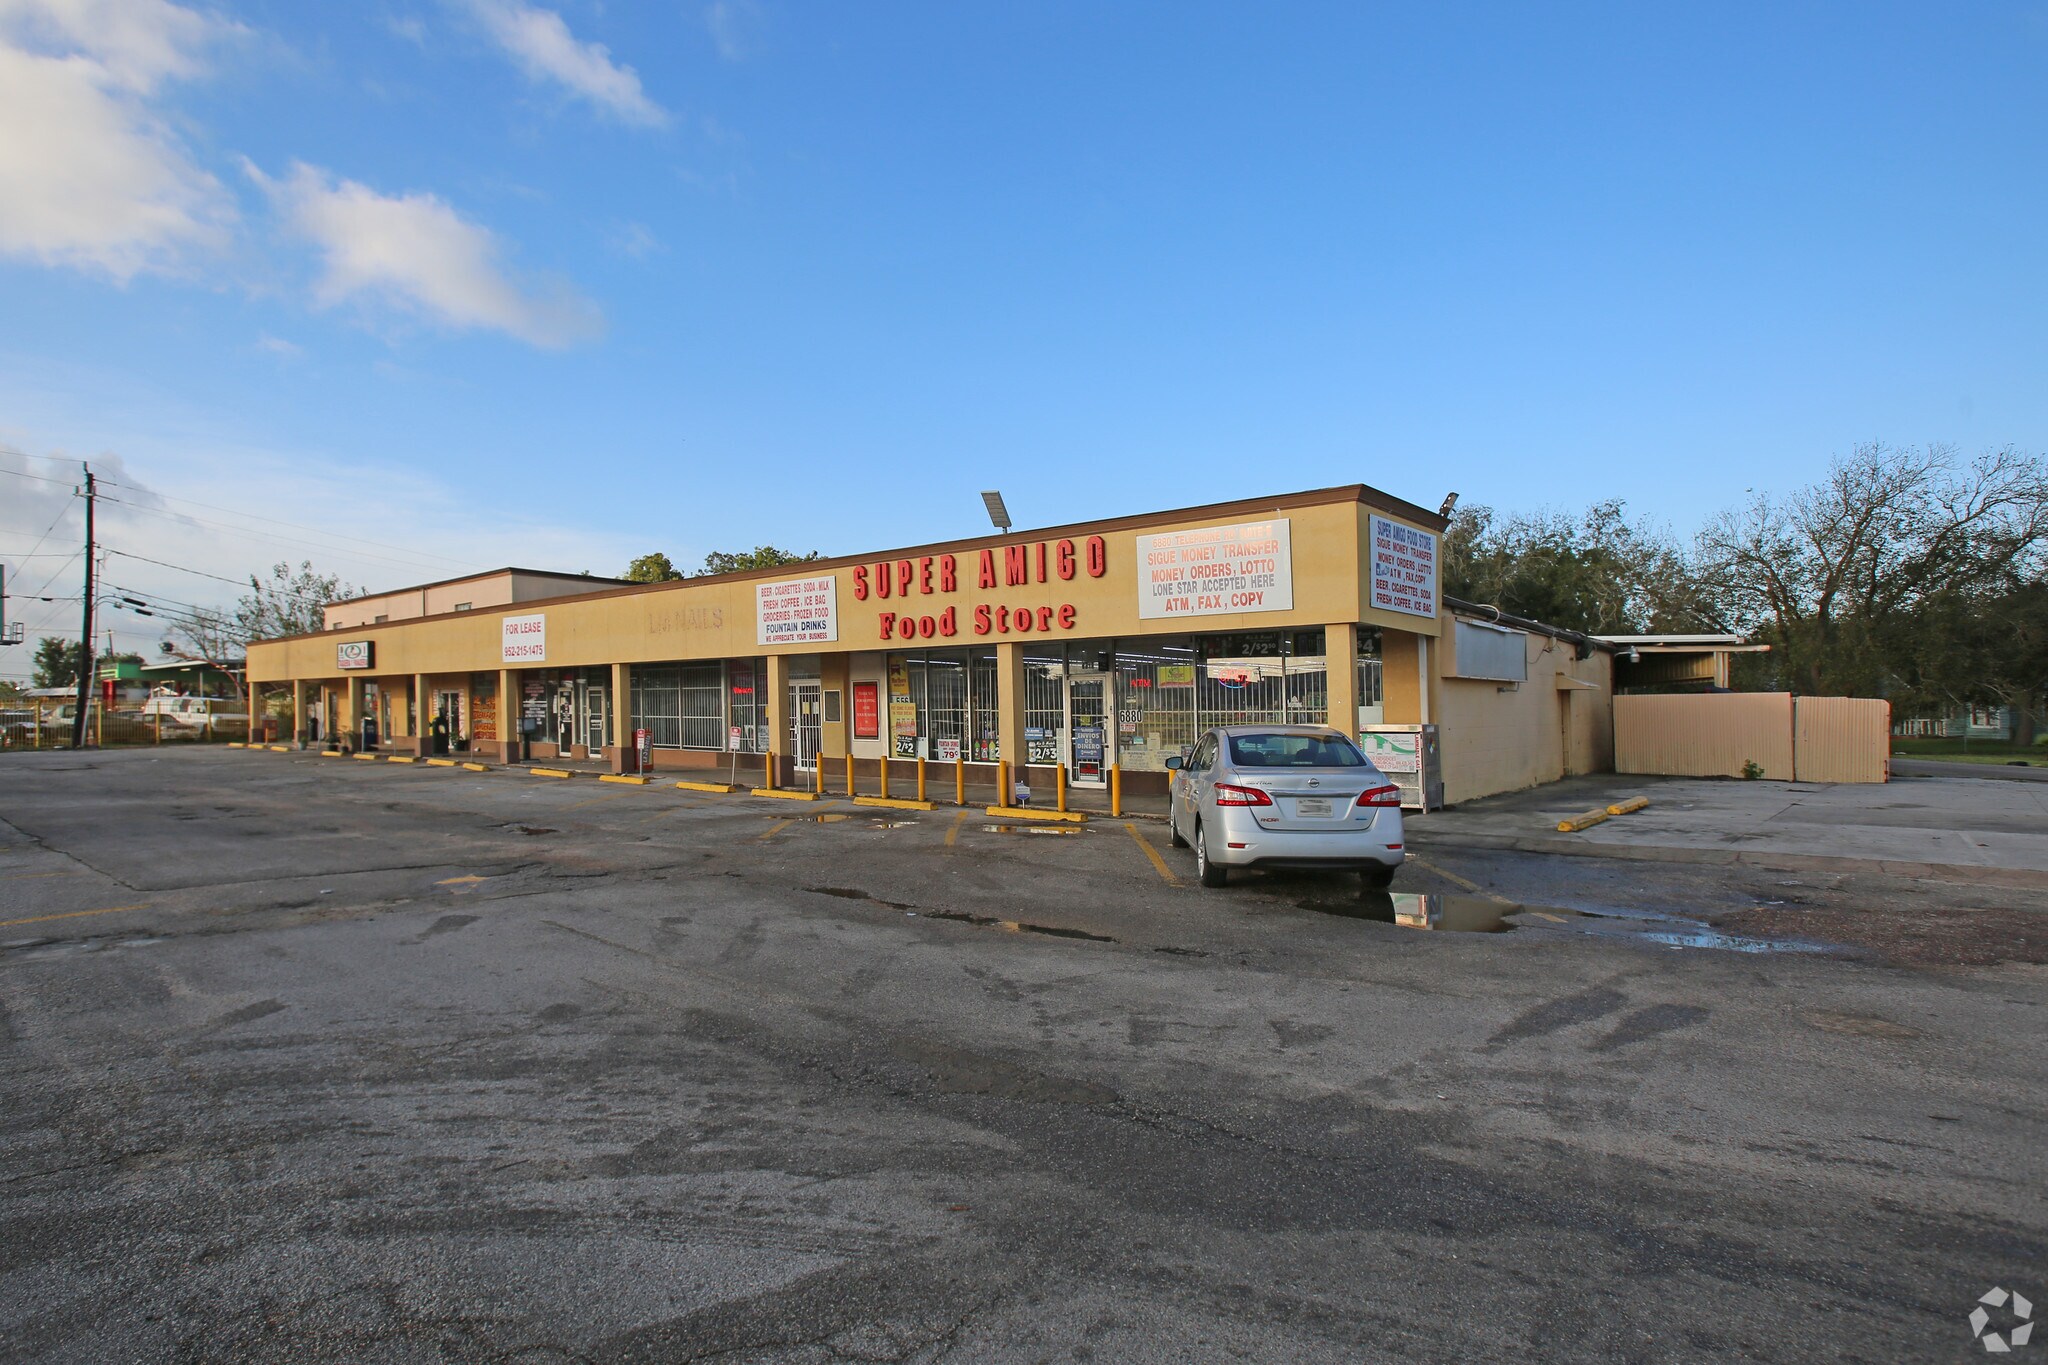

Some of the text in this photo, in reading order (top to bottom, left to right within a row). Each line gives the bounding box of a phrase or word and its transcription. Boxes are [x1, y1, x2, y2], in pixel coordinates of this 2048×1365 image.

[1148, 540, 1278, 566] SIGUE MONEY TRANSFER
[1392, 542, 1408, 555] MONEY
[853, 536, 1105, 600] SUPER AMIGO
[1152, 568, 1185, 582] MONEY
[1240, 558, 1275, 574] LOTTO
[1152, 574, 1274, 596] LONE STAR ACCEPTED HERE
[763, 600, 778, 610] FRESH
[804, 596, 812, 606] ICE
[815, 594, 826, 605] BAG
[1231, 592, 1264, 607] COPY
[1376, 592, 1392, 604] FRESH
[794, 608, 812, 620] FROZEN
[815, 607, 828, 618] FOOD
[506, 622, 541, 634] FOR LEASE
[766, 620, 826, 633] FOUNTAIN DRINKS
[879, 604, 1076, 640] Food Store
[1120, 710, 1142, 722] 6880
